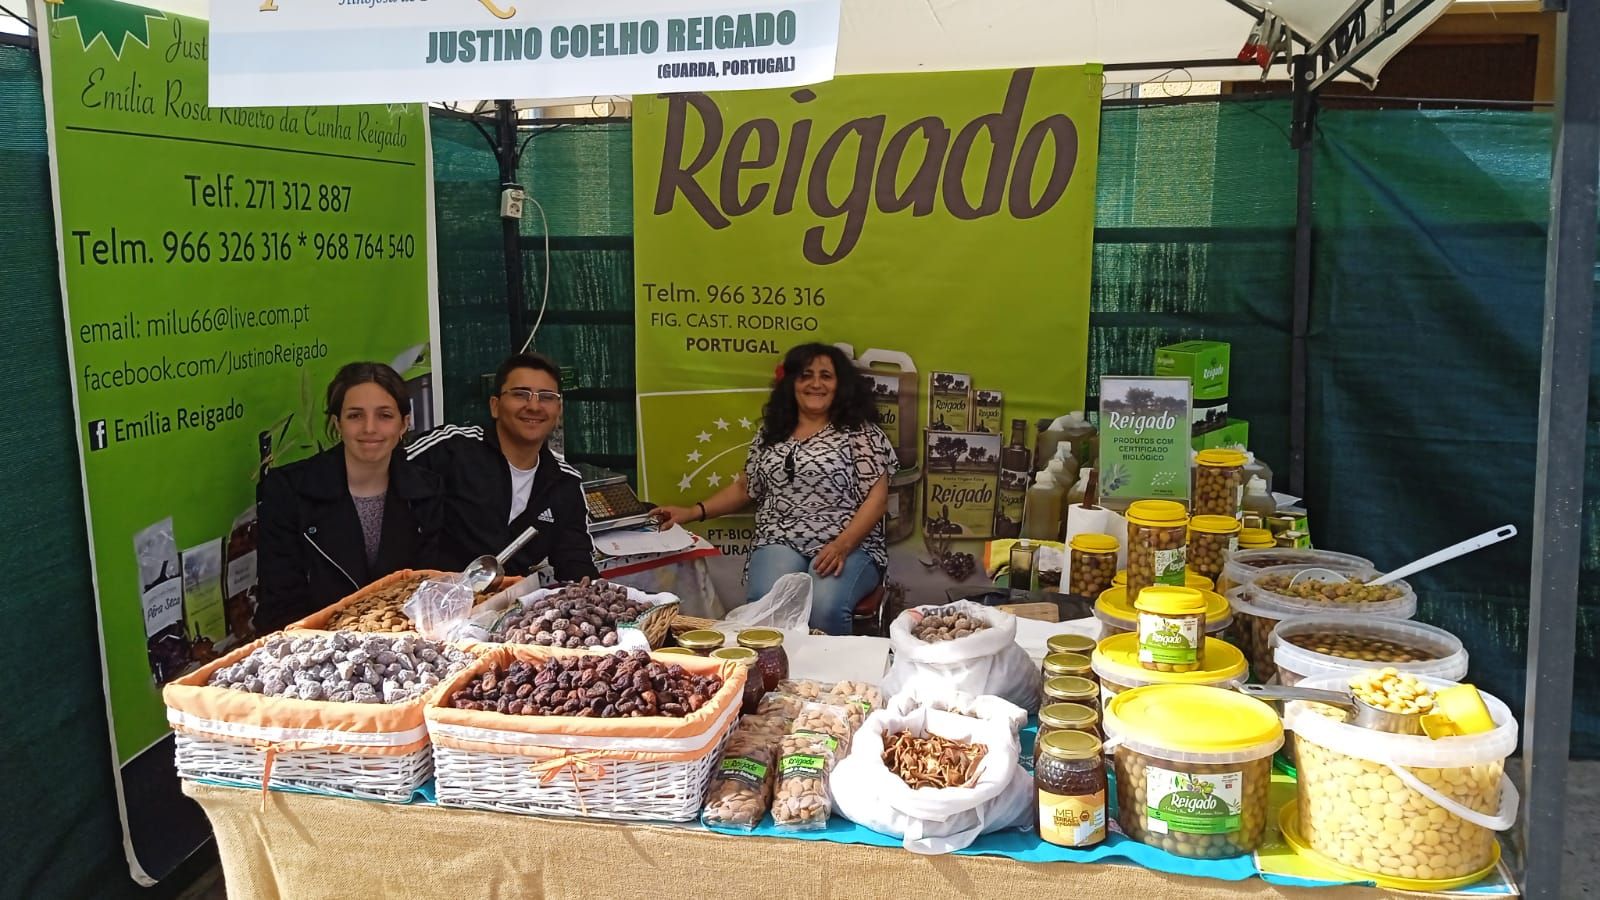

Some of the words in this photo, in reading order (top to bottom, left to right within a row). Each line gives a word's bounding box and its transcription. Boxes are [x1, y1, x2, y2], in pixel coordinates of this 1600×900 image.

[426, 27, 543, 65] JUSTINO
[549, 20, 659, 60] COELHO
[666, 10, 797, 53] REIGADO
[657, 61, 719, 80] (GUARDA,
[722, 56, 796, 77] PORTUGAL)
[81, 68, 155, 116] Emília
[165, 78, 211, 121] Rosa
[279, 106, 299, 134] da
[303, 105, 352, 141] Cunha
[357, 111, 407, 153] Reigado
[653, 67, 1078, 265] Reigado
[184, 173, 239, 209] Telf.
[244, 178, 275, 210] 271
[282, 180, 312, 211] 312
[318, 185, 352, 213] 887
[72, 227, 154, 266] Telm.
[163, 230, 211, 265] 966
[218, 232, 255, 263] 326
[261, 232, 292, 261] 316
[313, 234, 349, 261] 968
[354, 233, 384, 260] 764
[388, 233, 415, 259] 540
[642, 282, 700, 304] Telm.
[706, 284, 745, 305] 966
[751, 285, 787, 306] 326
[792, 286, 826, 307] 316
[79, 311, 140, 344] email:
[147, 303, 310, 338] milu66@live.com.pt
[651, 312, 681, 329] FIG.
[686, 312, 732, 330] CAST.
[737, 313, 819, 332] RODRIGO
[685, 337, 780, 354] PORTUGAL
[83, 338, 328, 393] facebook.com/JustinoReigado
[935, 399, 967, 413] Reigado
[114, 412, 172, 443] Emília
[177, 399, 244, 435] Reigado
[1109, 410, 1176, 435] Reigado
[1113, 437, 1155, 445] PRODUTOS
[1118, 445, 1169, 454] CERTIFICADO
[1122, 453, 1165, 462] BIOLÓGICO
[931, 483, 992, 509] Reigado
[1170, 793, 1217, 812] Reigado
